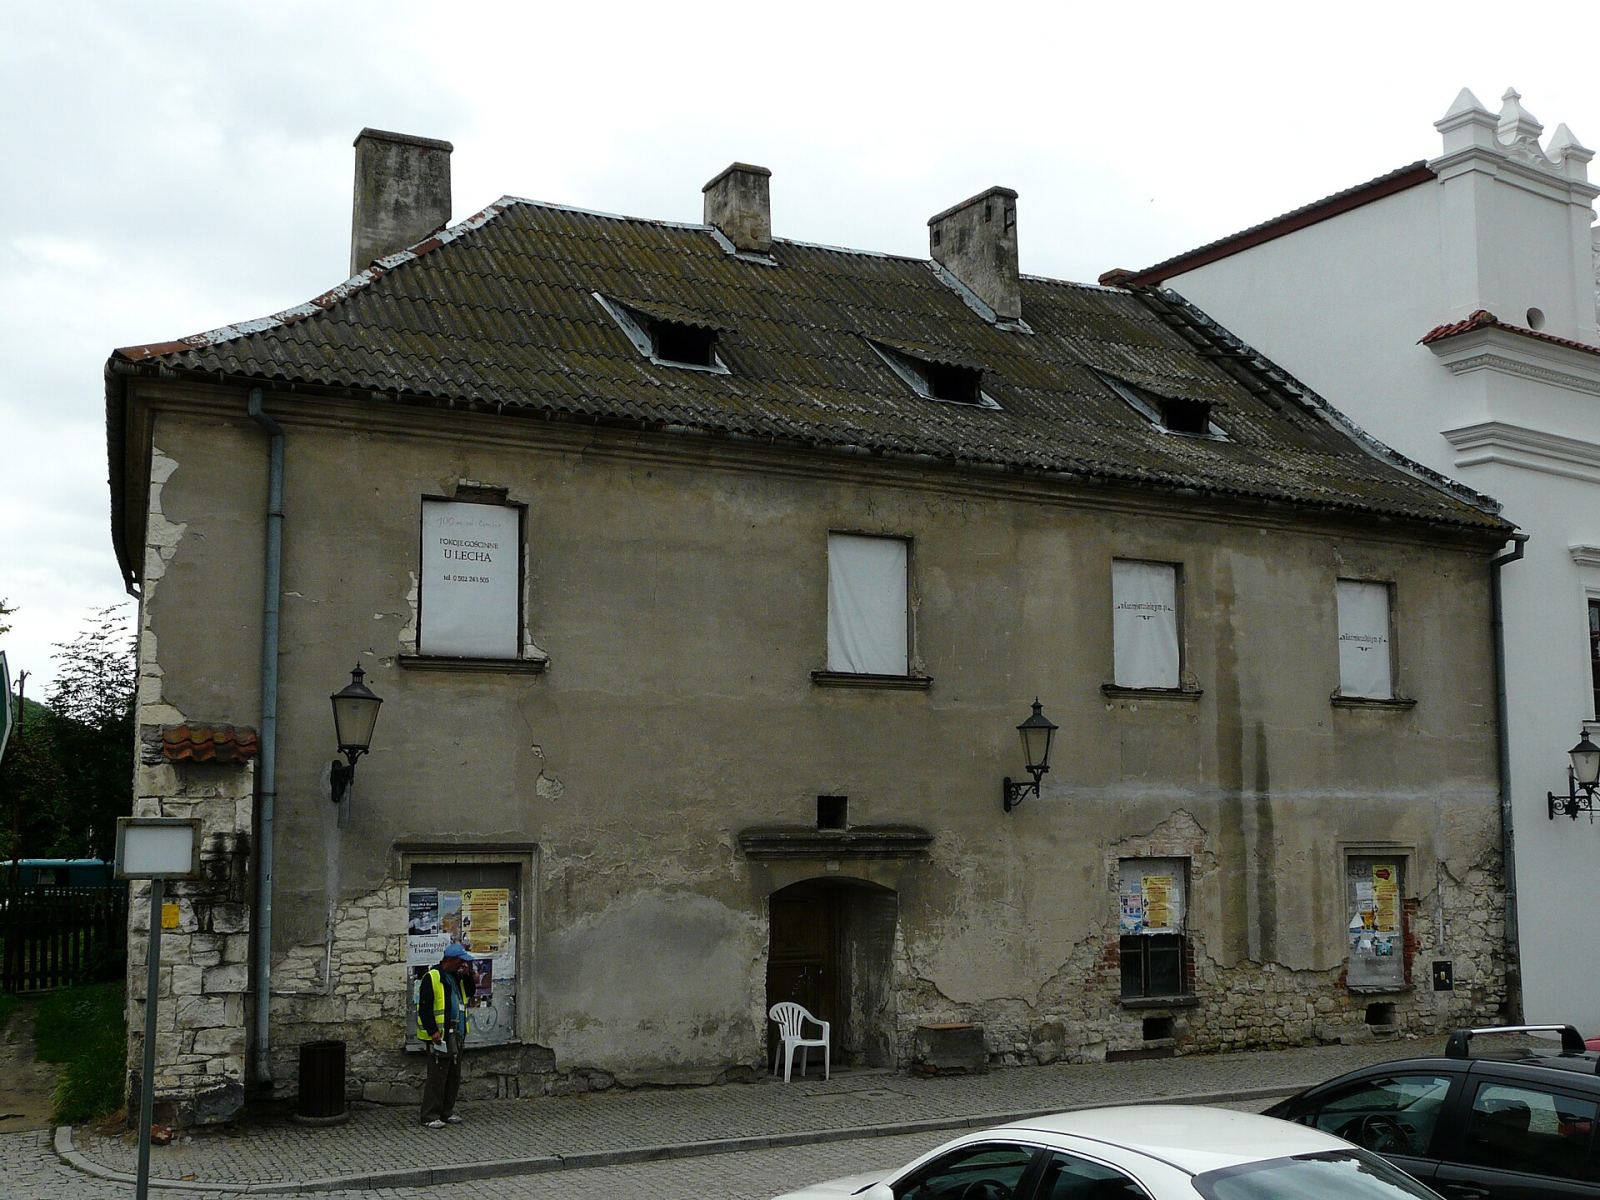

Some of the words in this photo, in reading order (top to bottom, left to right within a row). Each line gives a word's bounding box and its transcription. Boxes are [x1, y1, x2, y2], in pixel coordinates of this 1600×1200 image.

[440, 538, 464, 547] POKOJE
[444, 549, 451, 558] U
[455, 550, 491, 562] LECHA
